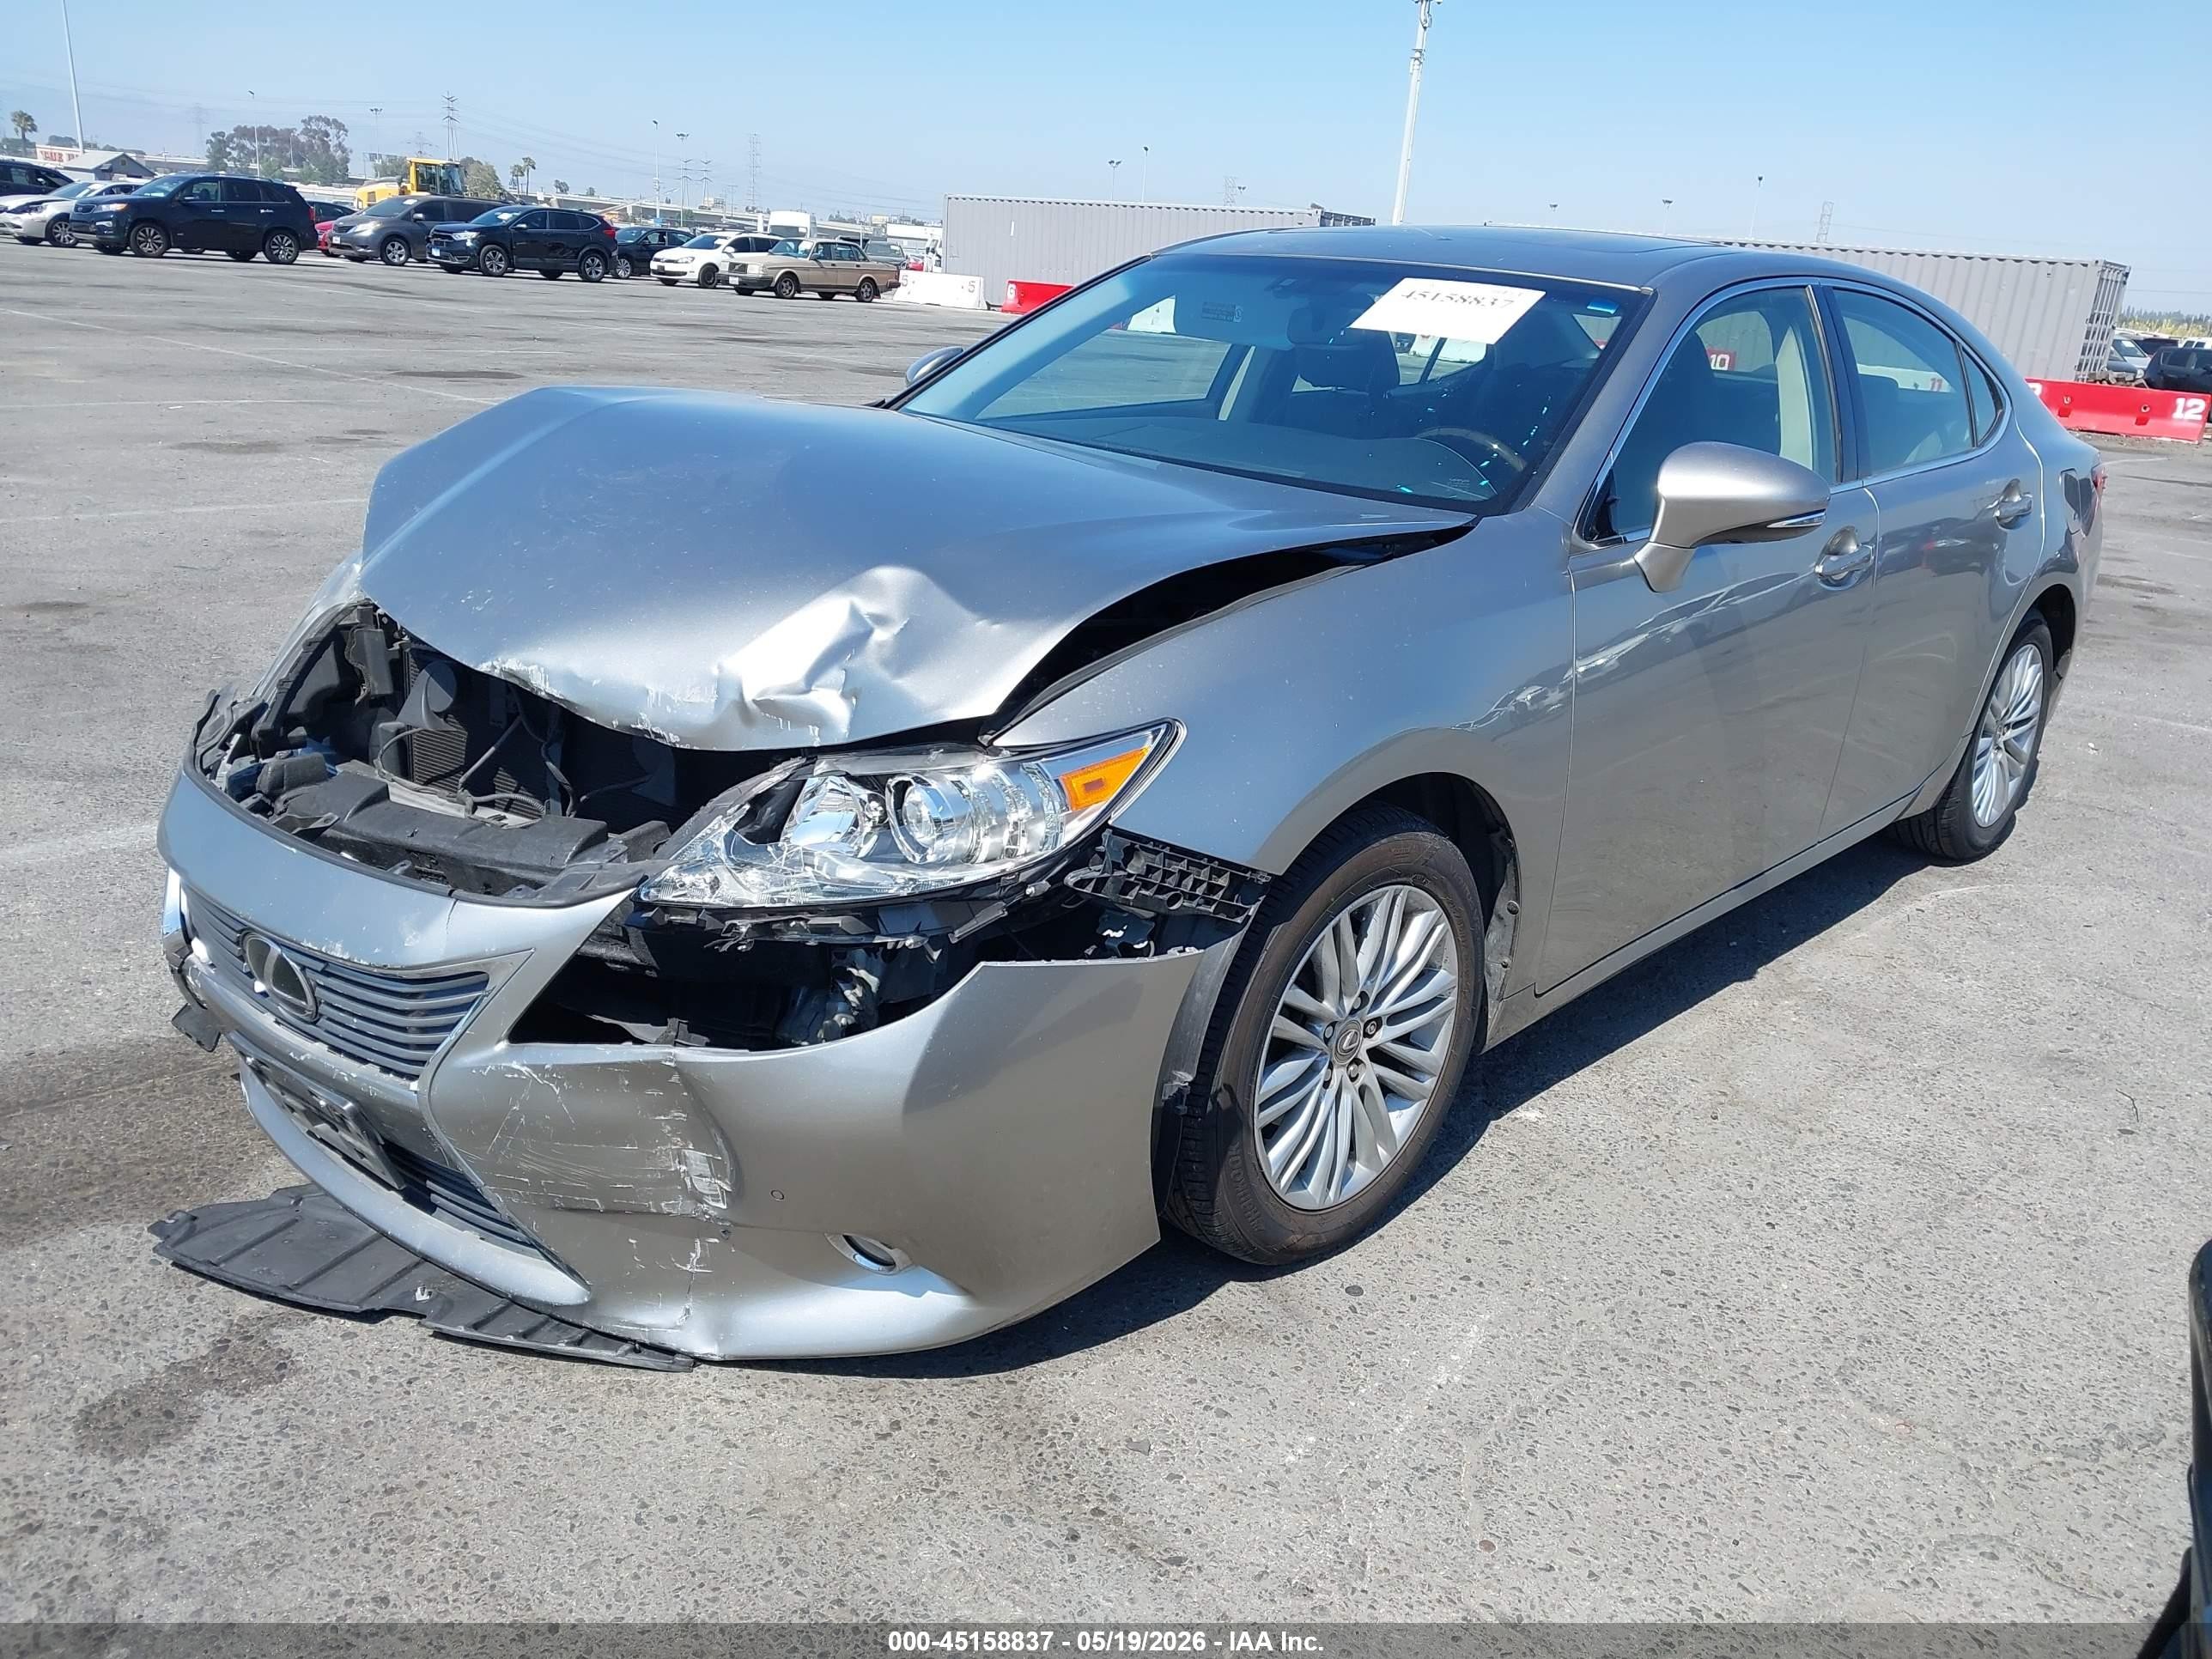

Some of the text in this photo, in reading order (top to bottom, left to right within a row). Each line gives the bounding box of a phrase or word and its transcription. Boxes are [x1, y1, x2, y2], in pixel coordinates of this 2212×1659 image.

[901, 274, 908, 287] 5
[968, 280, 975, 293] 5
[1401, 289, 1515, 308] 45158837
[1710, 354, 1730, 371] 10
[1930, 377, 1942, 392] 11
[2172, 397, 2206, 421] 12
